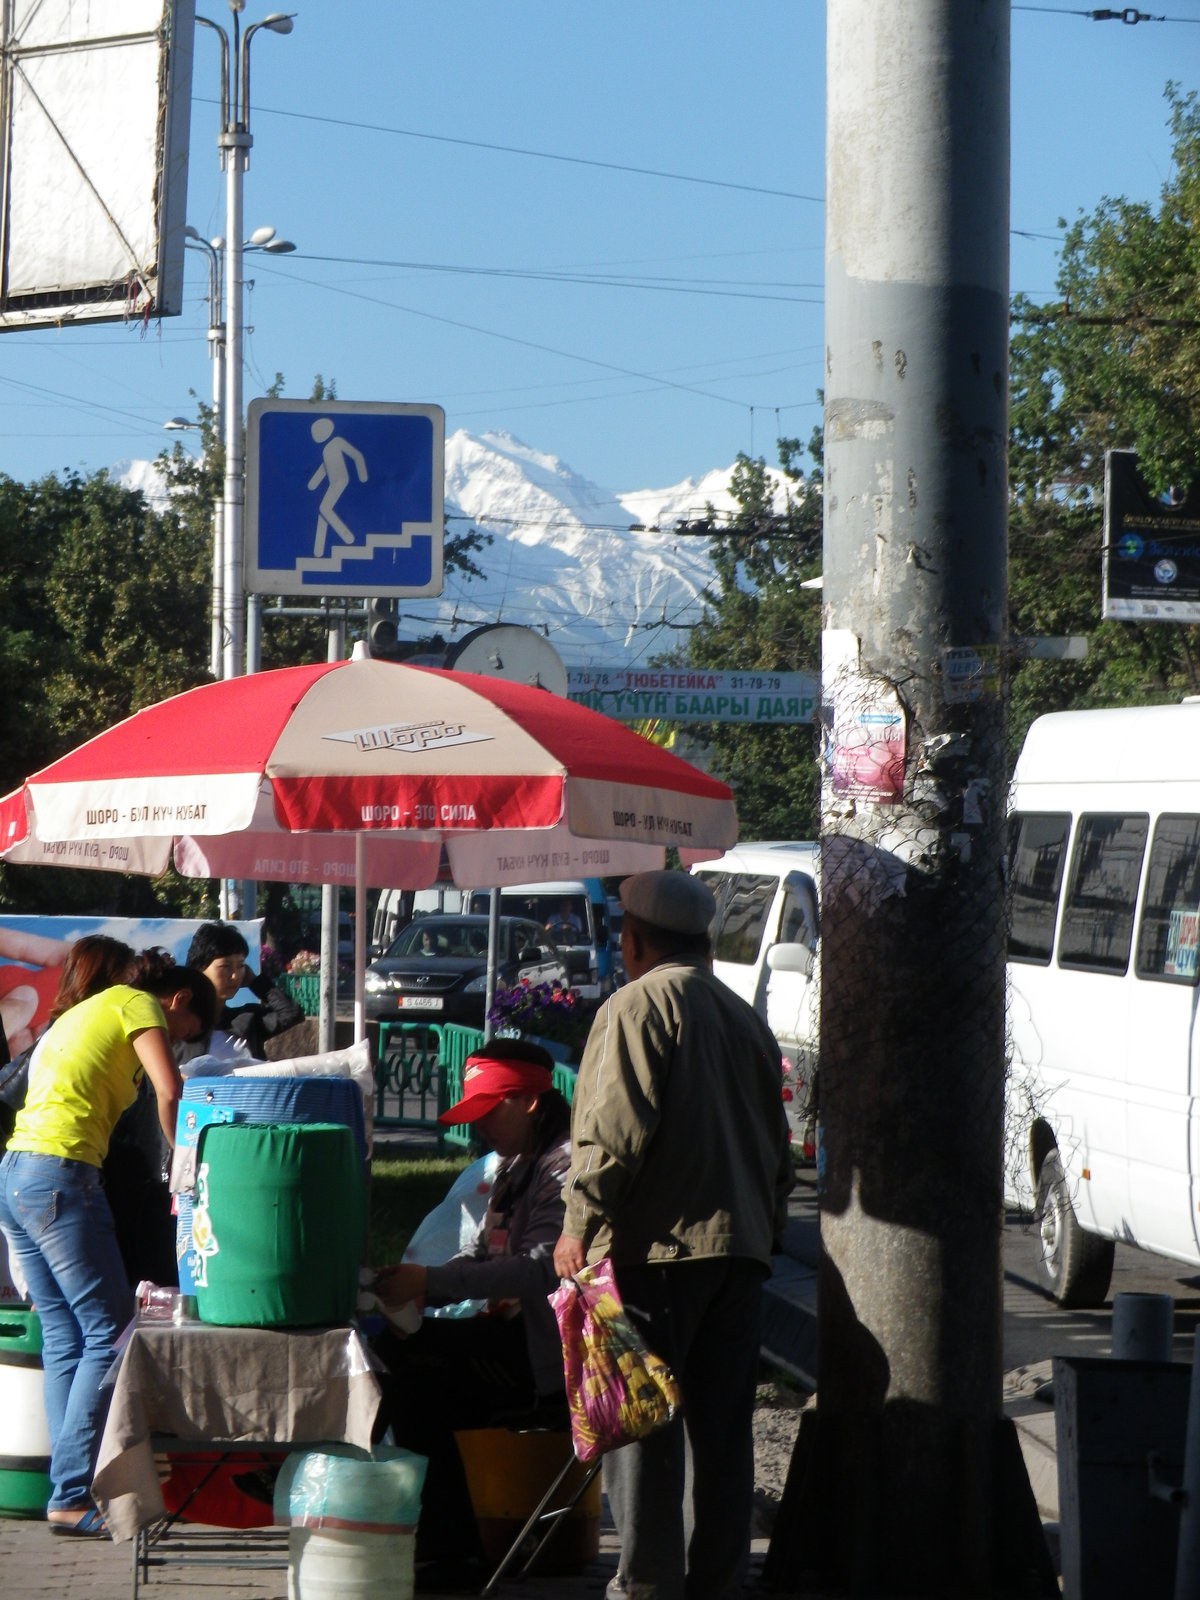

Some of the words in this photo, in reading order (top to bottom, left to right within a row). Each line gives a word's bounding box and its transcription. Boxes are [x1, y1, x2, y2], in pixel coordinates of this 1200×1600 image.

[731, 677, 781, 690] 31-79-79
[675, 695, 750, 716] БААРЫ
[756, 697, 814, 720] ДАЯР
[87, 809, 118, 825] ШОРО
[176, 804, 207, 820] КУБАТ
[361, 805, 399, 822] ШОРО
[415, 804, 436, 820] ЭТО
[441, 804, 477, 821] СИЛА
